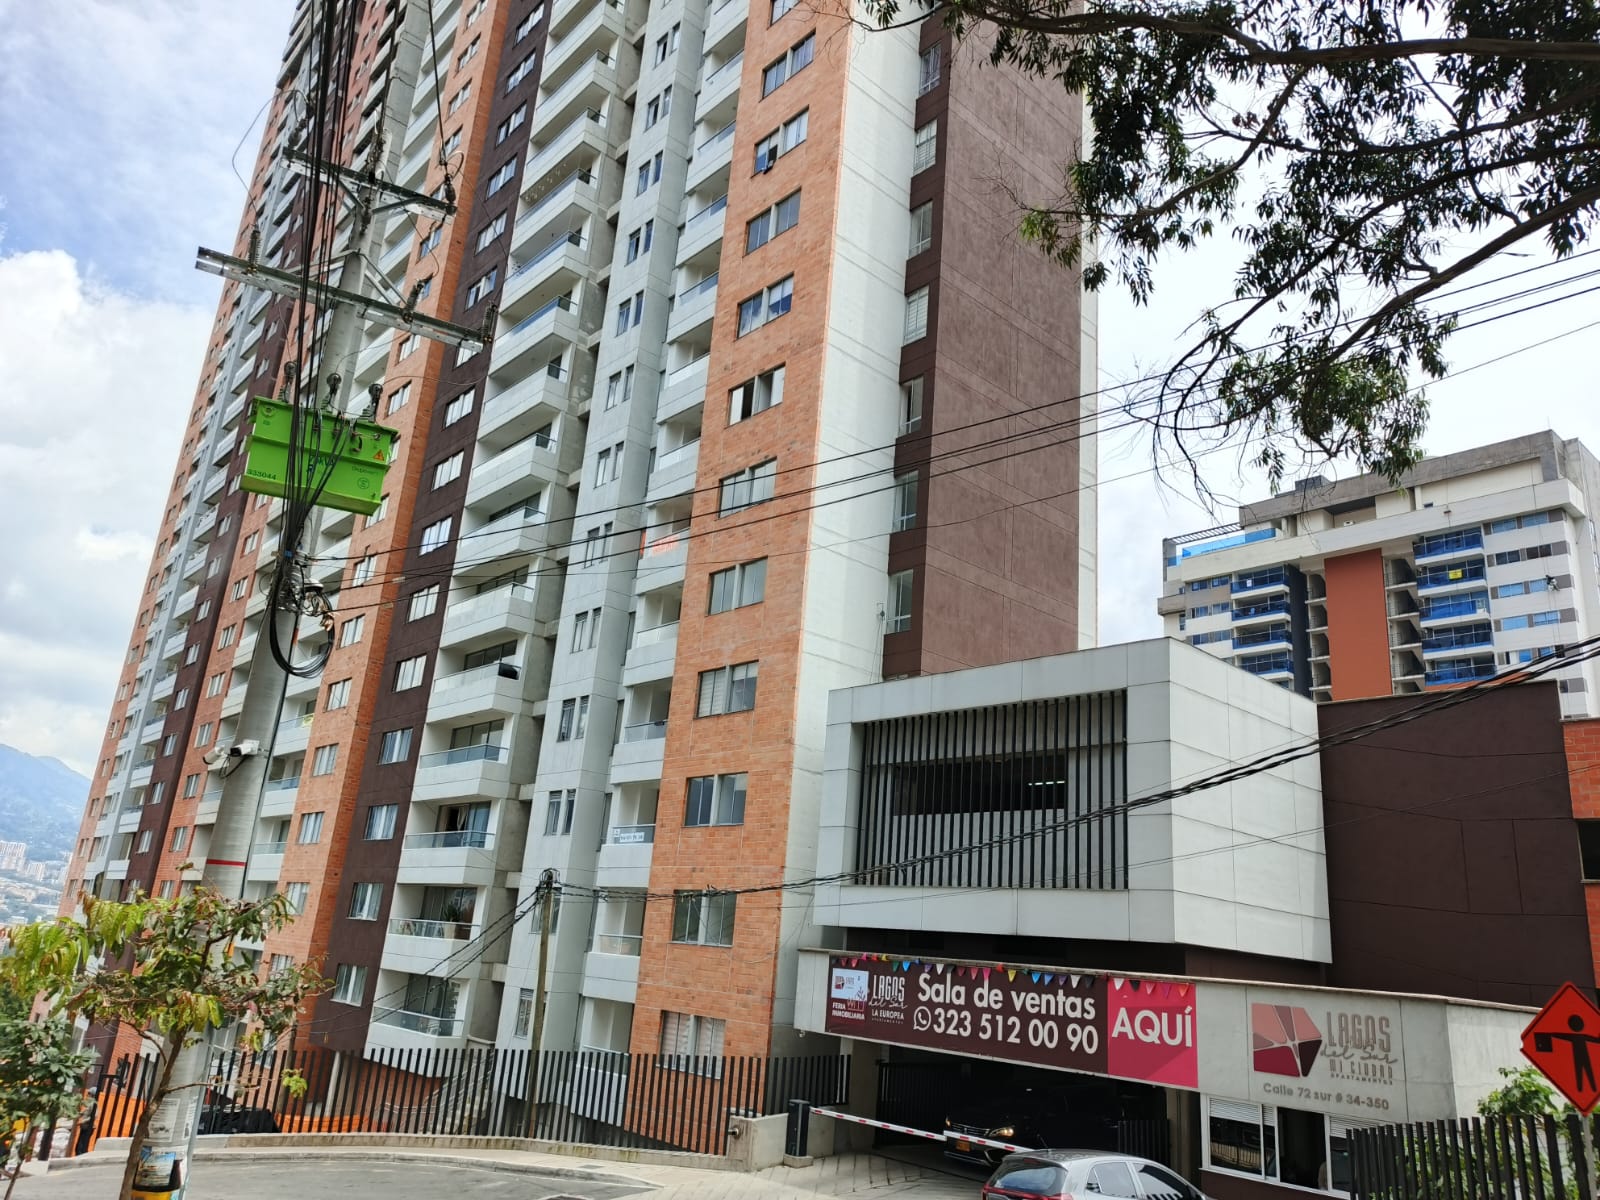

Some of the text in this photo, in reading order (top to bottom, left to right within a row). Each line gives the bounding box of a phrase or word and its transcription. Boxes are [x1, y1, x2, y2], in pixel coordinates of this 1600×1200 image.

[873, 974, 906, 1002] LAGOS
[917, 972, 1096, 1020] Sala de ventas
[871, 1008, 905, 1020] LA EUROPEA
[933, 1007, 1099, 1055] 323 512 00 90
[1111, 1005, 1193, 1048] AQUÍ
[1326, 1011, 1391, 1053] LAGOS
[1329, 1058, 1393, 1079] MI CIUDAD
[1263, 1082, 1294, 1097] Calle
[1297, 1086, 1312, 1099] 72
[1313, 1091, 1332, 1102] sur
[1346, 1094, 1389, 1110] 34-350
